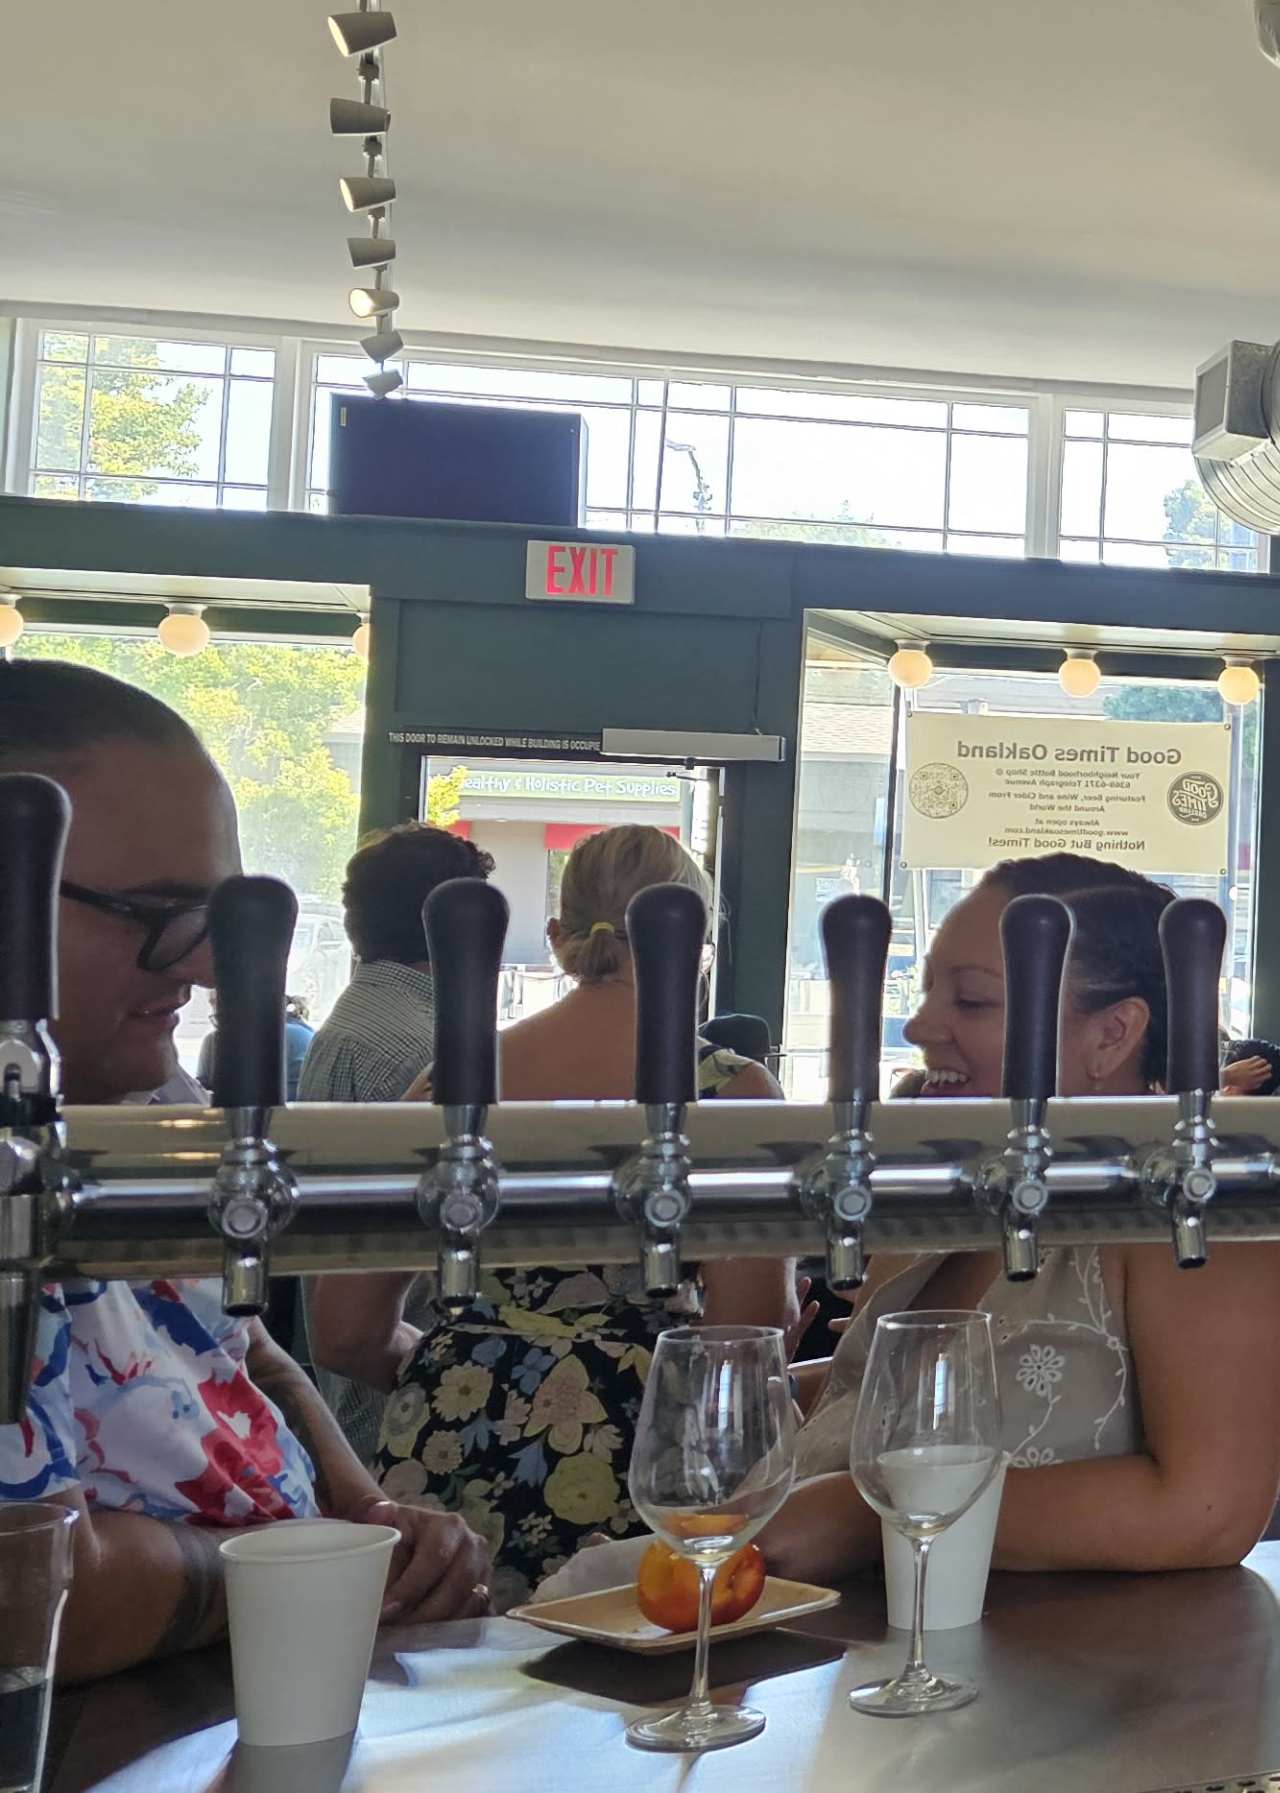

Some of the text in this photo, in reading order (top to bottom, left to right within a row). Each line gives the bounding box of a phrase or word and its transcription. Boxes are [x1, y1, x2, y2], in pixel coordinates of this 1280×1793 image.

[546, 545, 619, 597] EXIT
[388, 732, 601, 751] THIS DOOR TO REMAIN UNLOCKED WHILE BUILDING IS OCCUPIE
[525, 777, 580, 792] Holistic
[585, 780, 612, 793] Pet
[616, 780, 678, 796] Supplies
